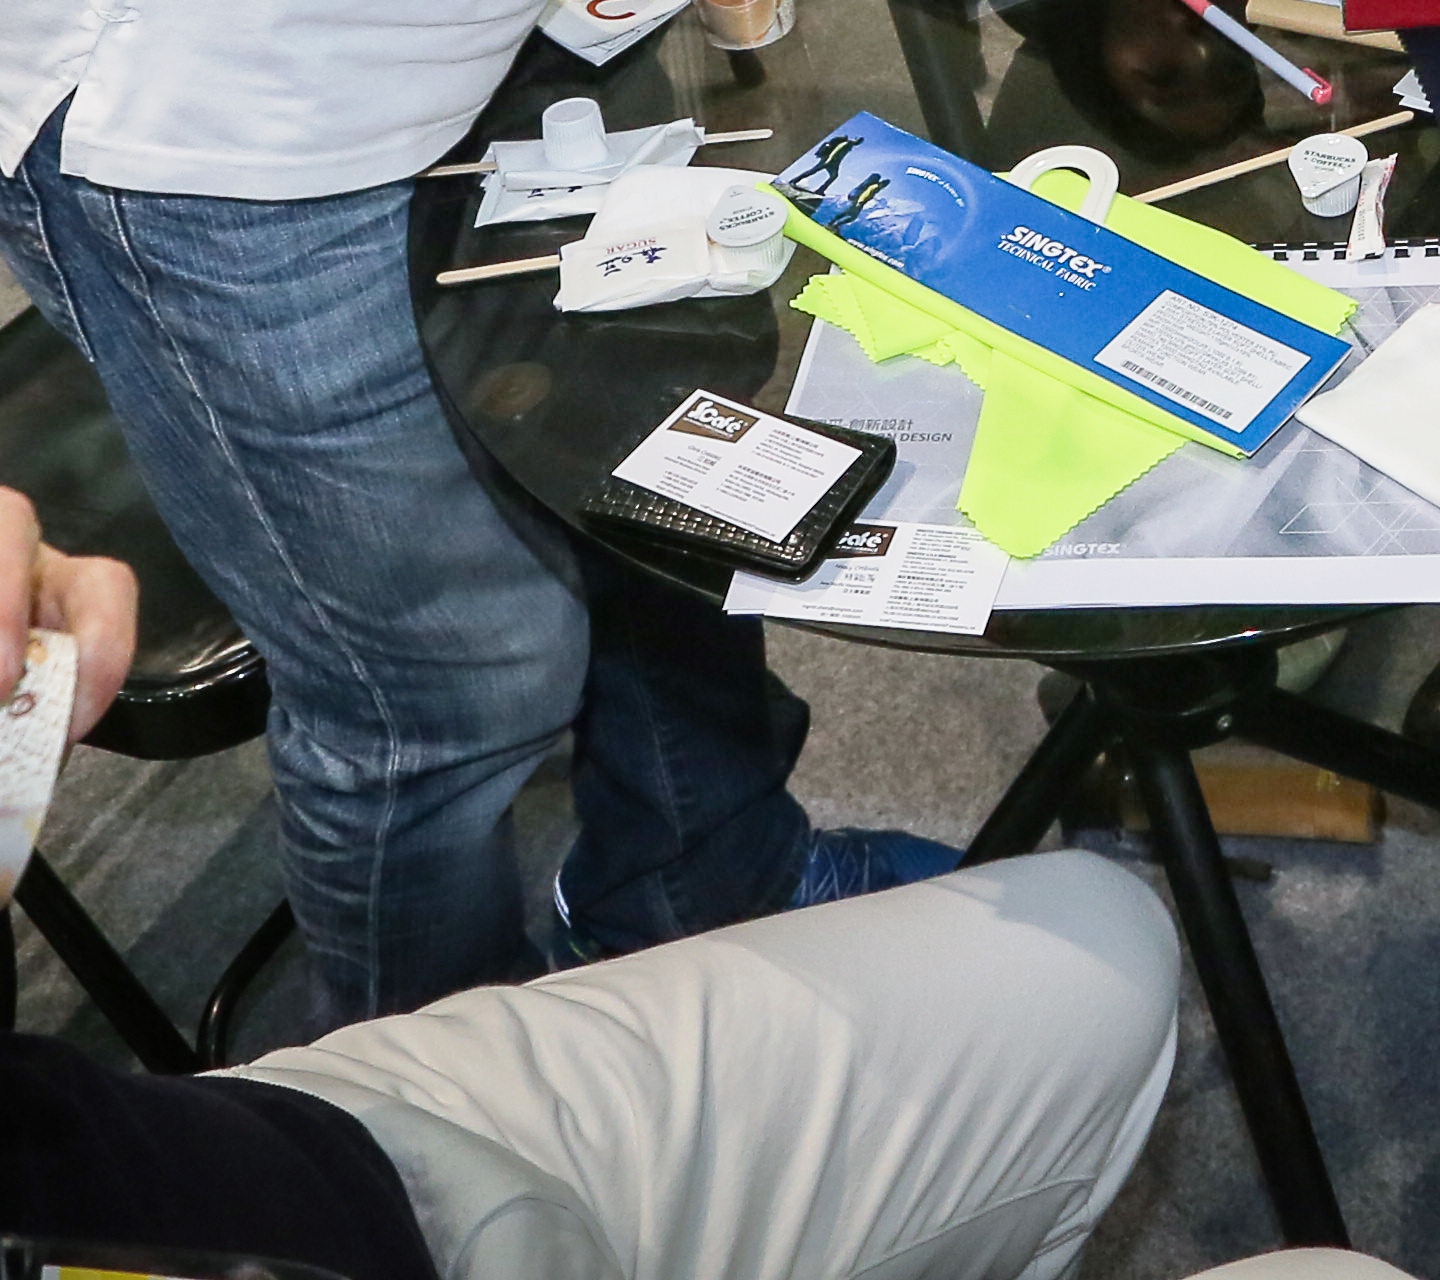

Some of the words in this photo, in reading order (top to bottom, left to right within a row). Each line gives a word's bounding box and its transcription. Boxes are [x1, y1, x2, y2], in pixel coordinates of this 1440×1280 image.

[1303, 149, 1356, 164] STARBUCKS
[718, 210, 775, 231] STARBUCKS
[605, 236, 657, 255] SUGAR
[996, 240, 1056, 272] TECHNICAL
[1055, 265, 1097, 293] FABRIC
[899, 432, 953, 442] DESIGN
